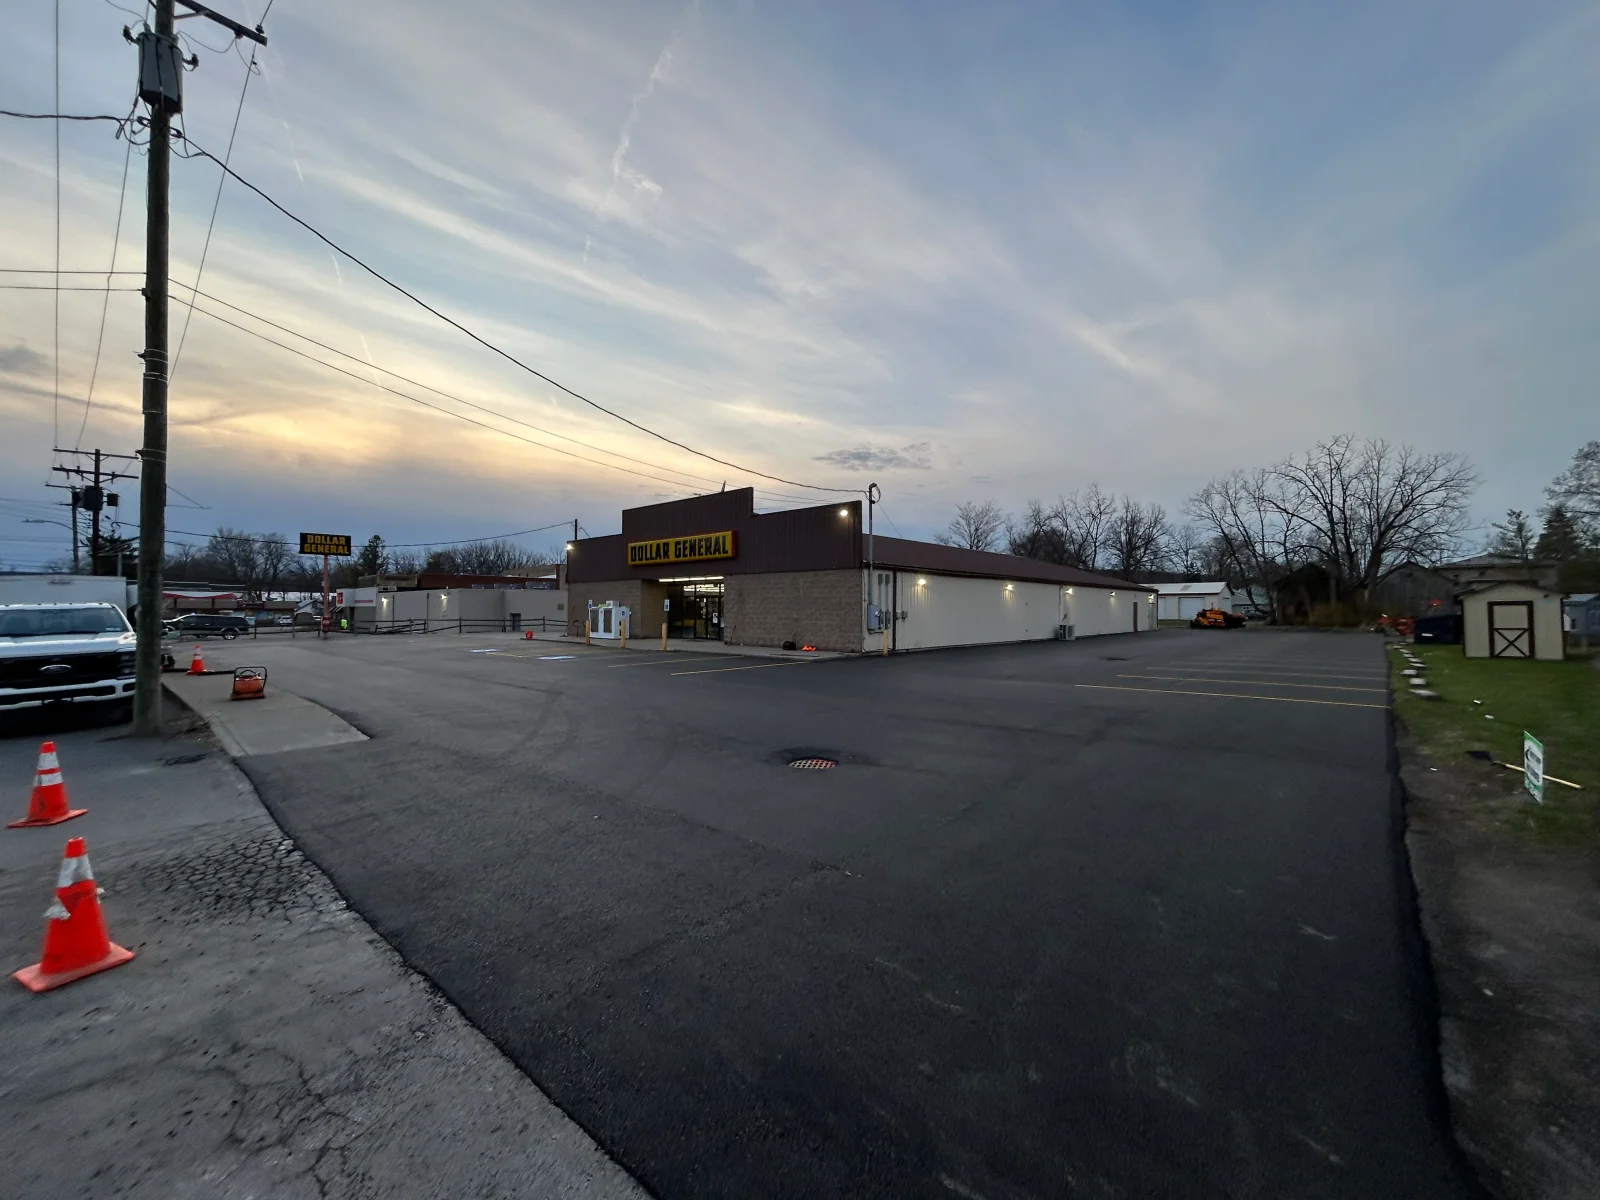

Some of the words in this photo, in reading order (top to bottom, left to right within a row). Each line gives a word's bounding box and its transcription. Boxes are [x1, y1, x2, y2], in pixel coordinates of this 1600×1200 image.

[306, 534, 346, 545] DOLLAR
[303, 544, 349, 554] GENERAL
[630, 542, 670, 562] DOLLAR
[674, 535, 729, 559] GENERAL
